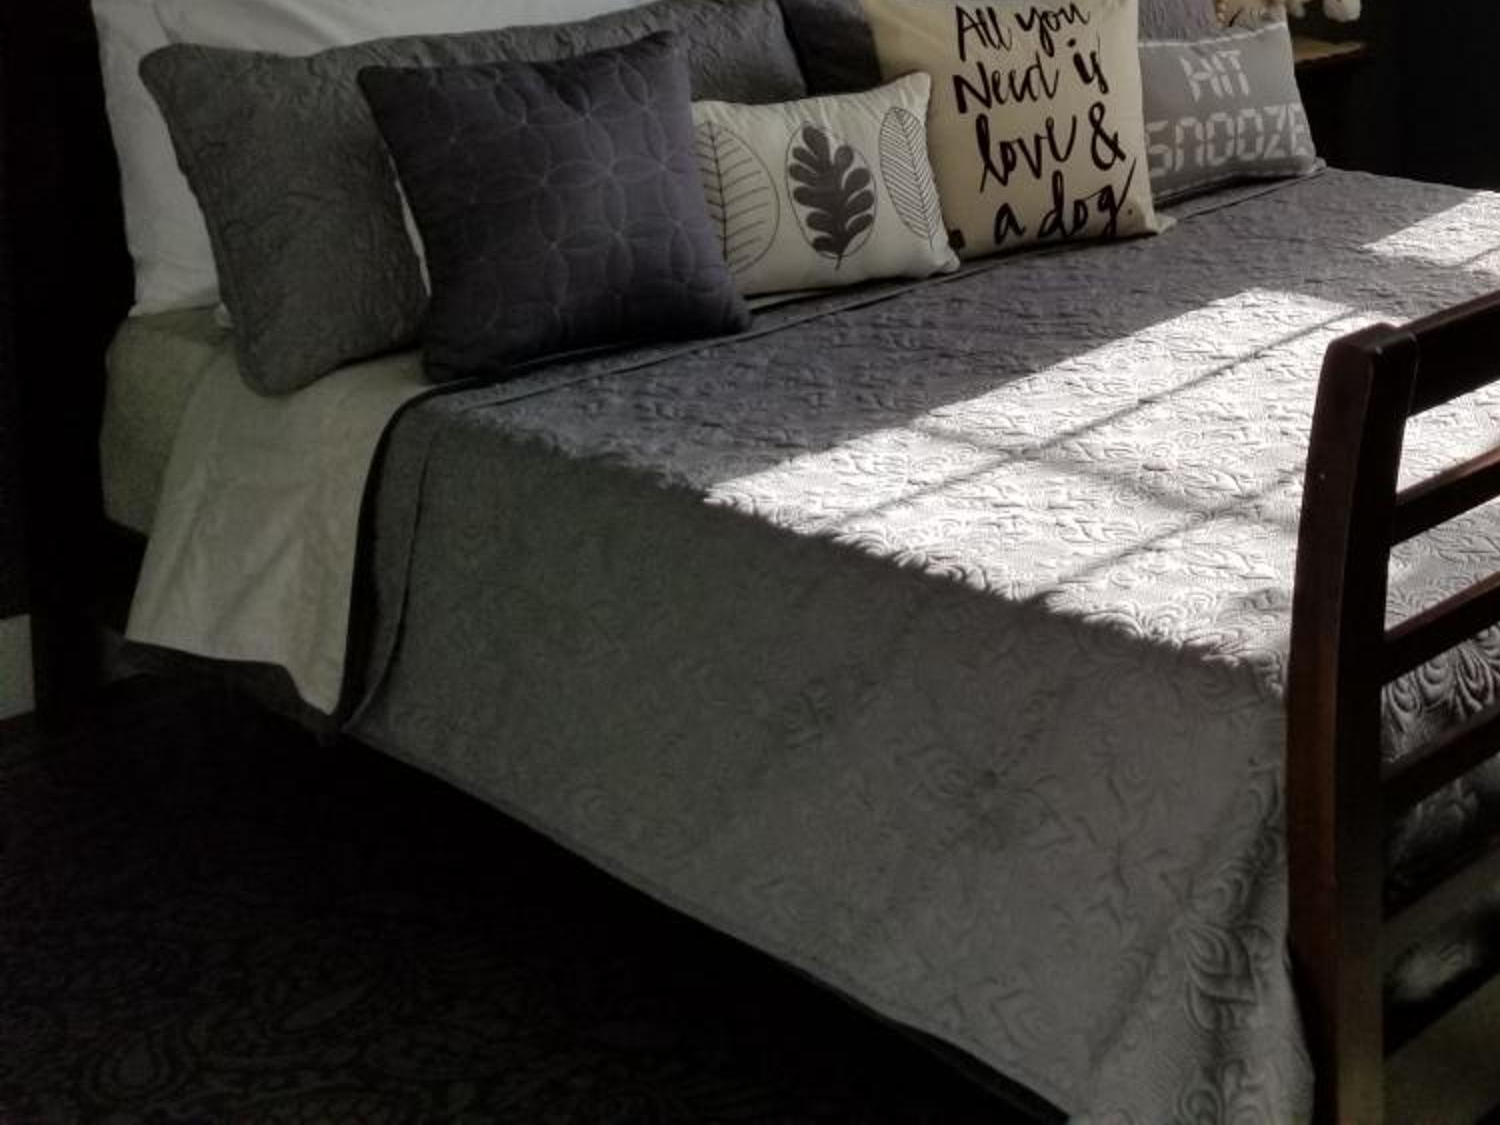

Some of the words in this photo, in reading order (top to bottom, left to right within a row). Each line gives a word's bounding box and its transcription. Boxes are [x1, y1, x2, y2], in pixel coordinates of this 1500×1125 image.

[956, 5, 1011, 62] All
[1015, 1, 1090, 56] you
[953, 53, 1060, 114] Need
[1068, 37, 1110, 94] is
[1179, 50, 1249, 102] HIT
[975, 112, 1077, 193] love
[1089, 100, 1127, 172] &
[994, 201, 1026, 245] a
